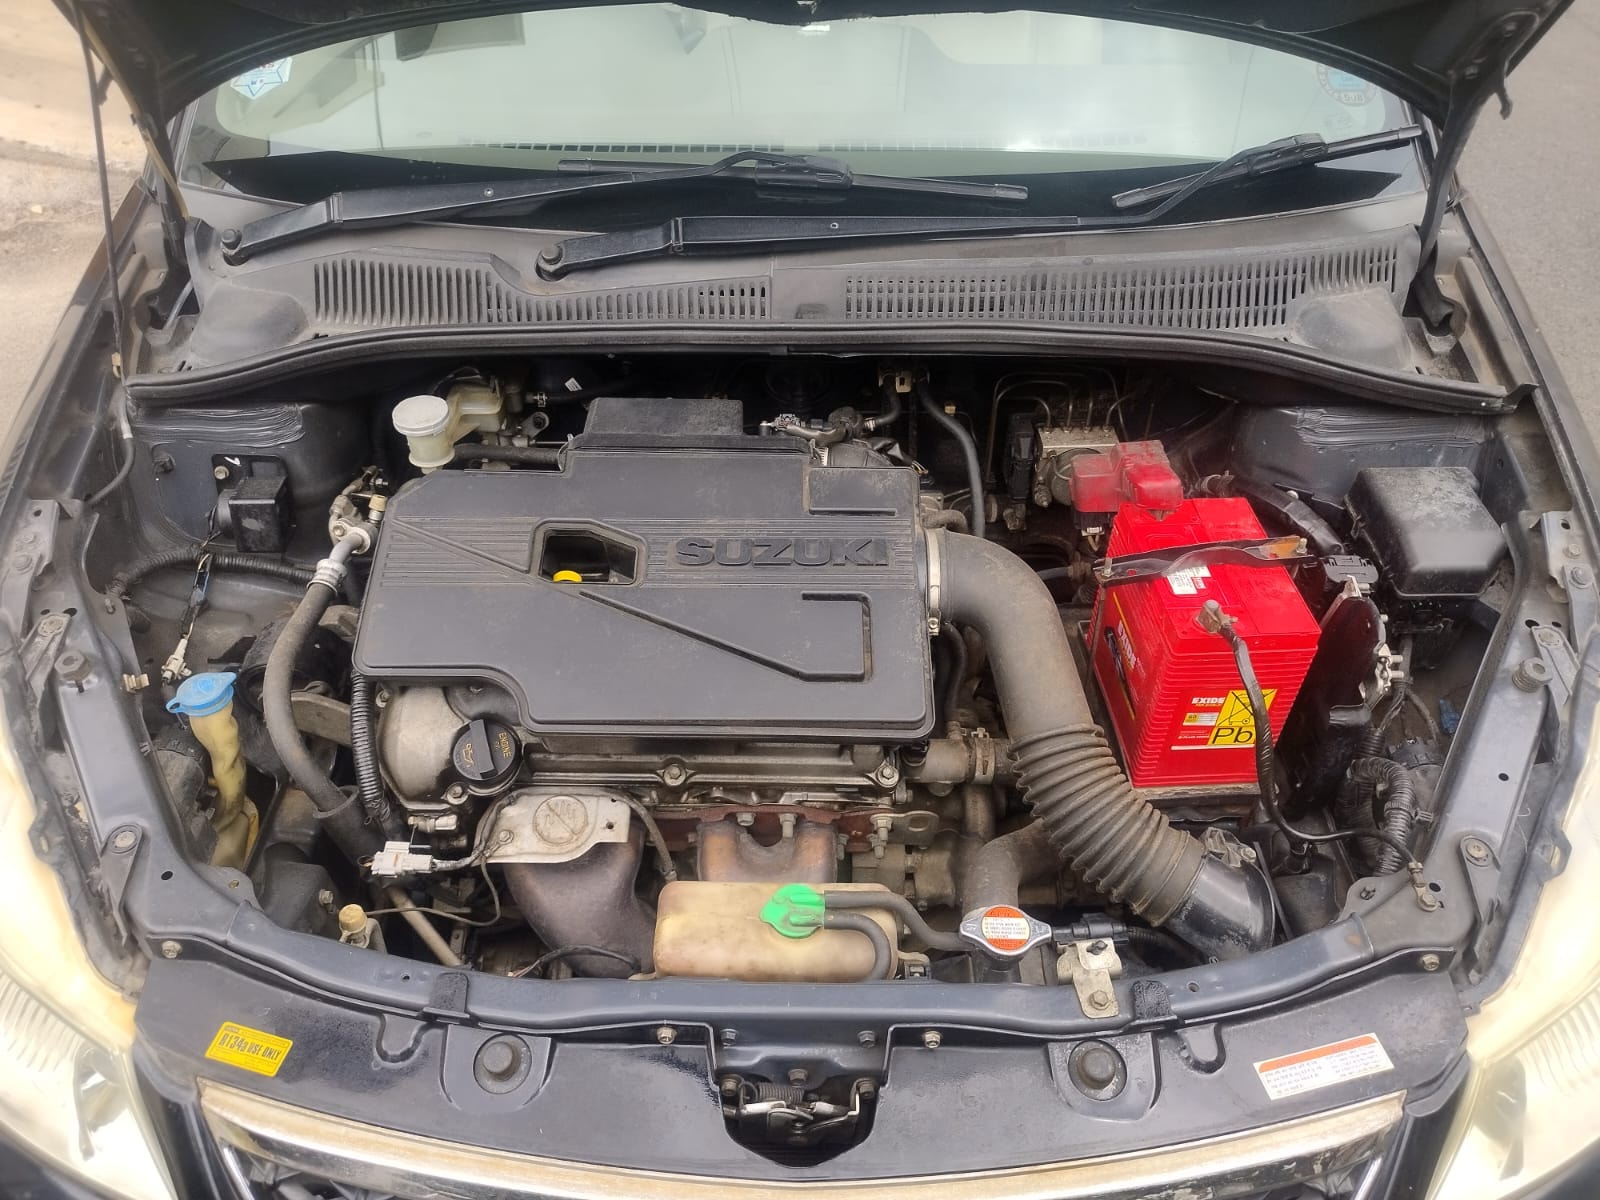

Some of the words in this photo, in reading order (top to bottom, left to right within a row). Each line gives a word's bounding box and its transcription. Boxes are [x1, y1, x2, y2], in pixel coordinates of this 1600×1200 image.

[675, 537, 889, 567] SUZUKI
[1117, 619, 1137, 669] EXIDE
[1212, 727, 1253, 744] Pb
[263, 1046, 282, 1060] ONLY
